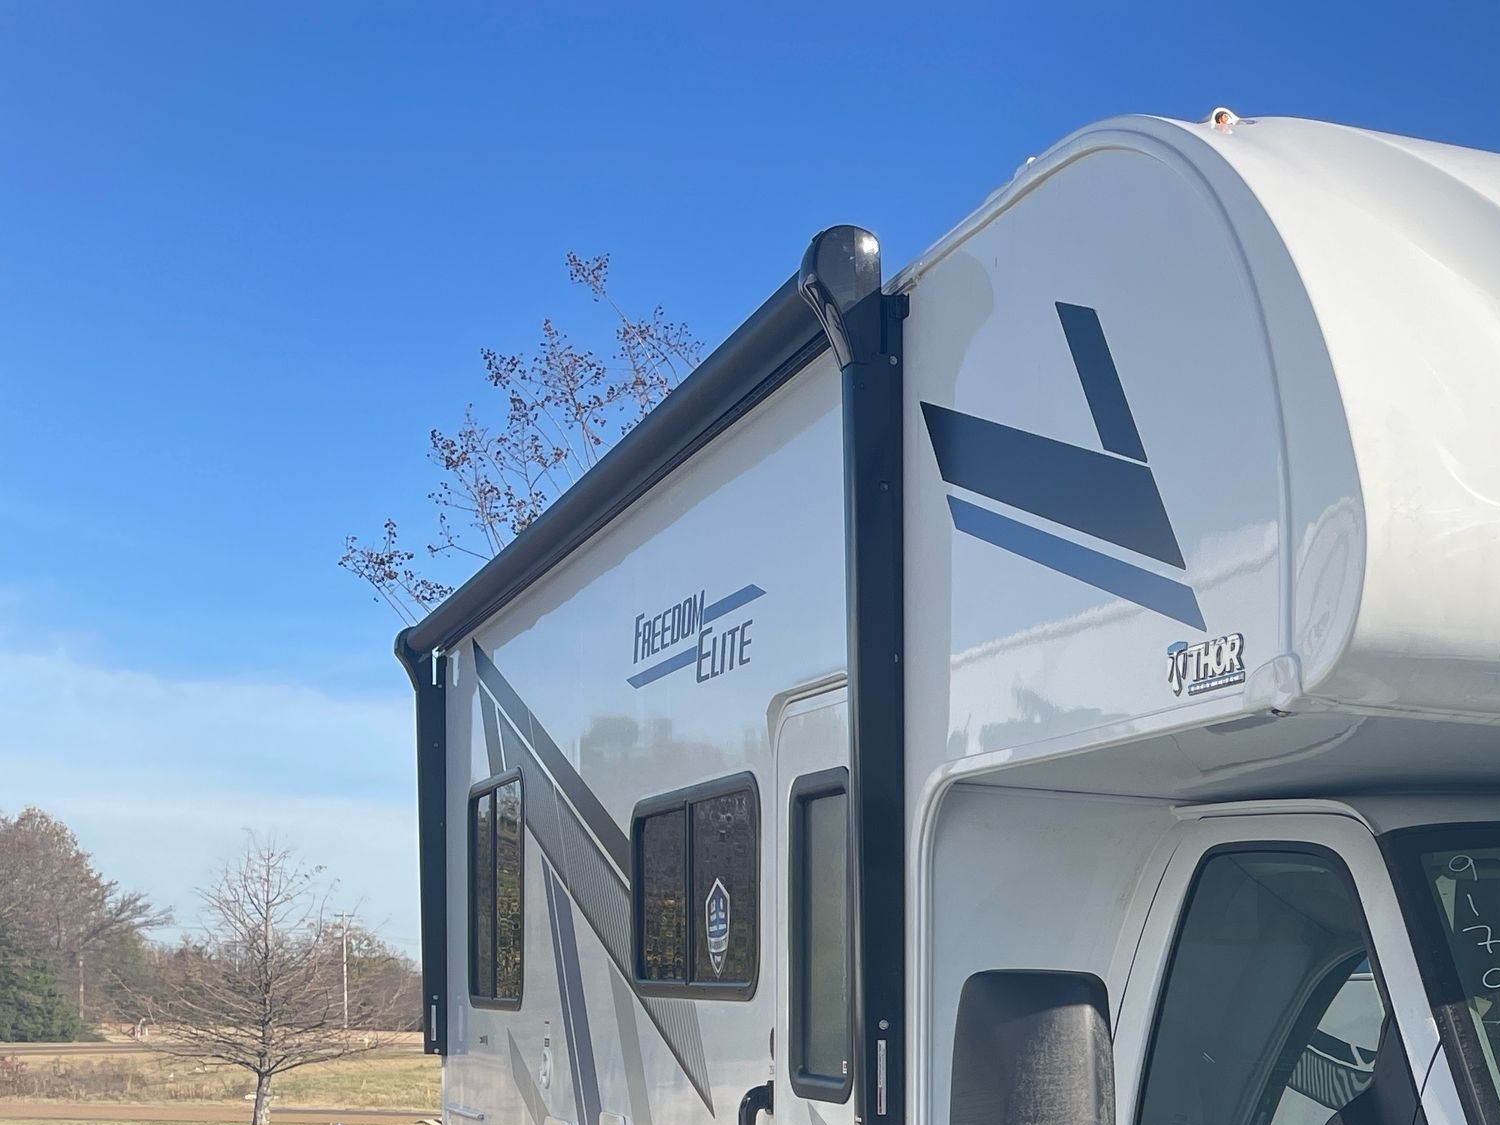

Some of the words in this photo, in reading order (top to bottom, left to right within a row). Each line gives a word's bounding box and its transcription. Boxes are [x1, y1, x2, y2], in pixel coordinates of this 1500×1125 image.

[633, 589, 705, 664] FREEDOM
[696, 619, 753, 684] ELITE
[1187, 632, 1245, 682] THOR
